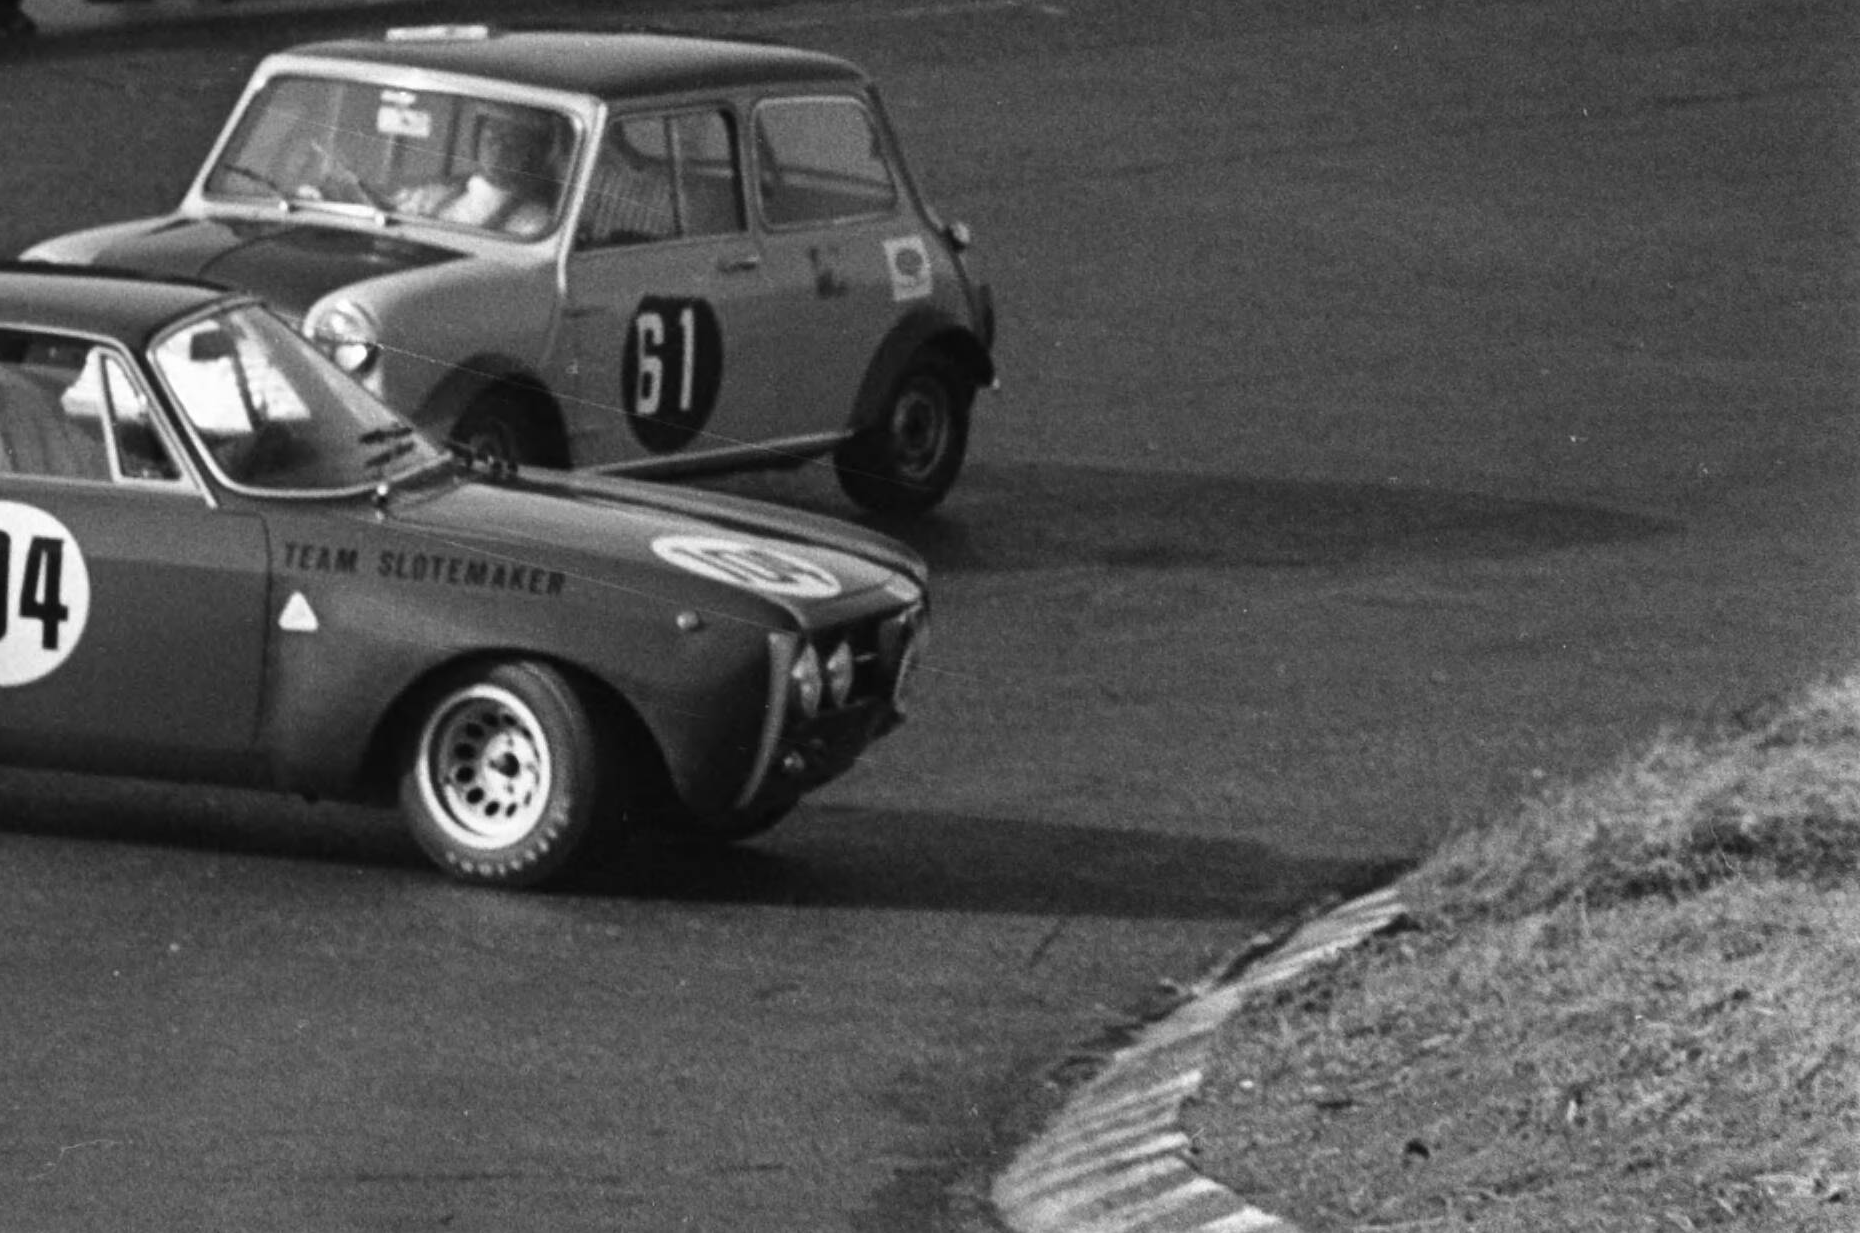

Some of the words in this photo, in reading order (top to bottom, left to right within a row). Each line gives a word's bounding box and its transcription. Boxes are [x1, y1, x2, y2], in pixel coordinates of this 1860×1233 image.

[636, 309, 695, 416] 61
[285, 541, 358, 574] TEAM
[379, 550, 566, 595] SLOTEMAKER
